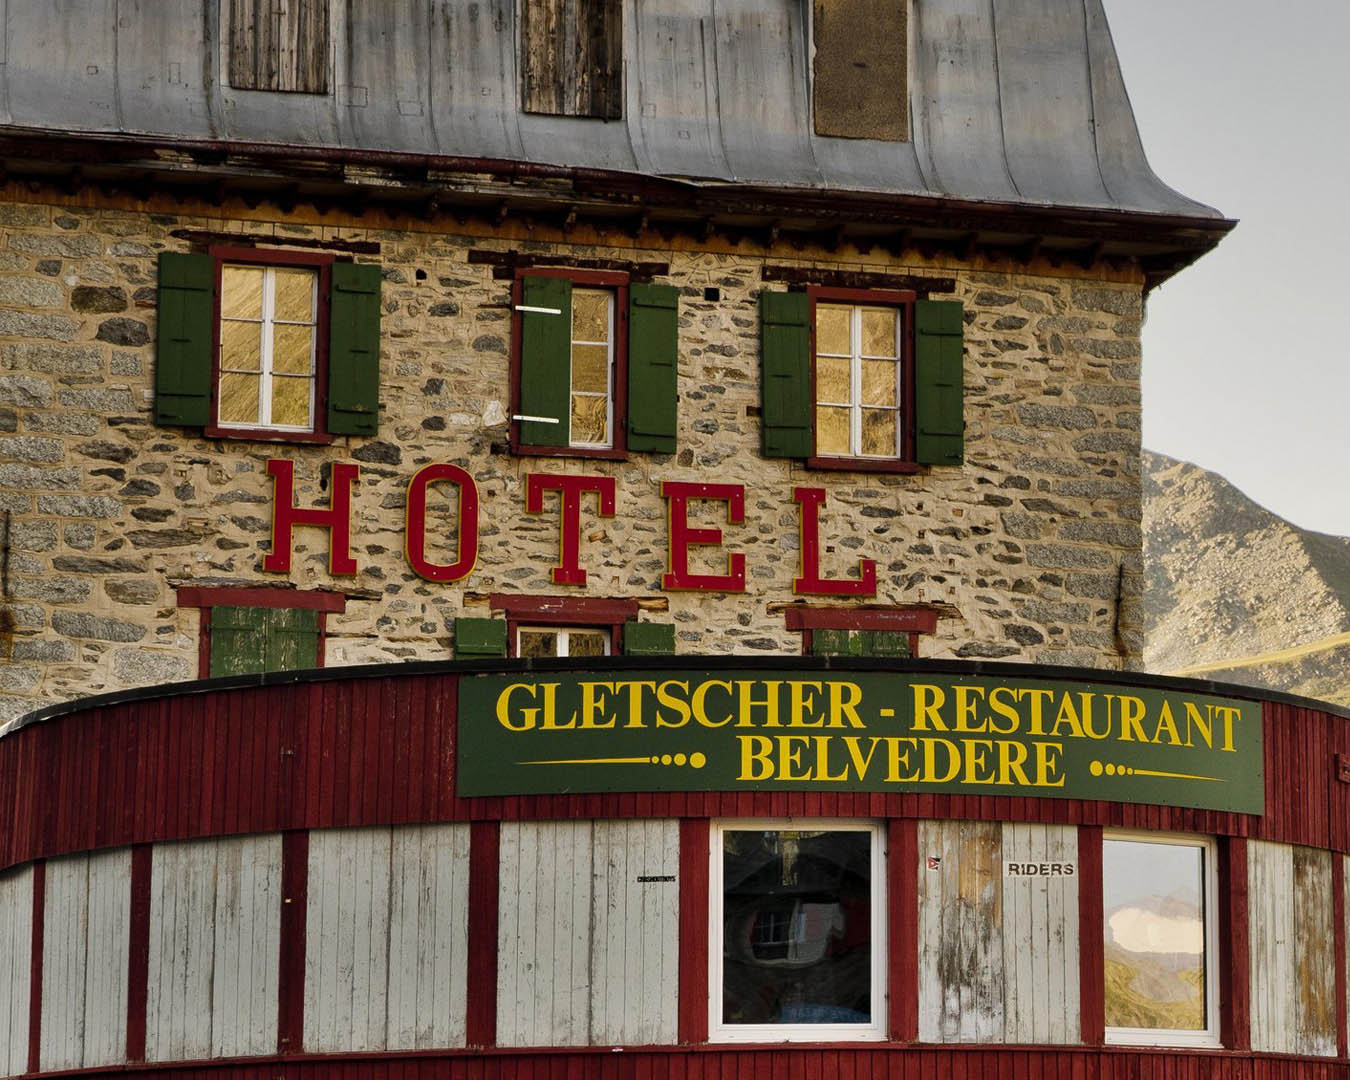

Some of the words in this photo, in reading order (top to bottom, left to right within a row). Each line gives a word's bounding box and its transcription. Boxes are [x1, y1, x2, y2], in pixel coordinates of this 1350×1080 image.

[263, 458, 877, 597] HOTEL
[496, 679, 867, 731] GLETSCHER
[909, 683, 1241, 753] RESTAURANT
[736, 735, 1066, 788] BELVEDERE
[1008, 863, 1074, 876] RIDERS
